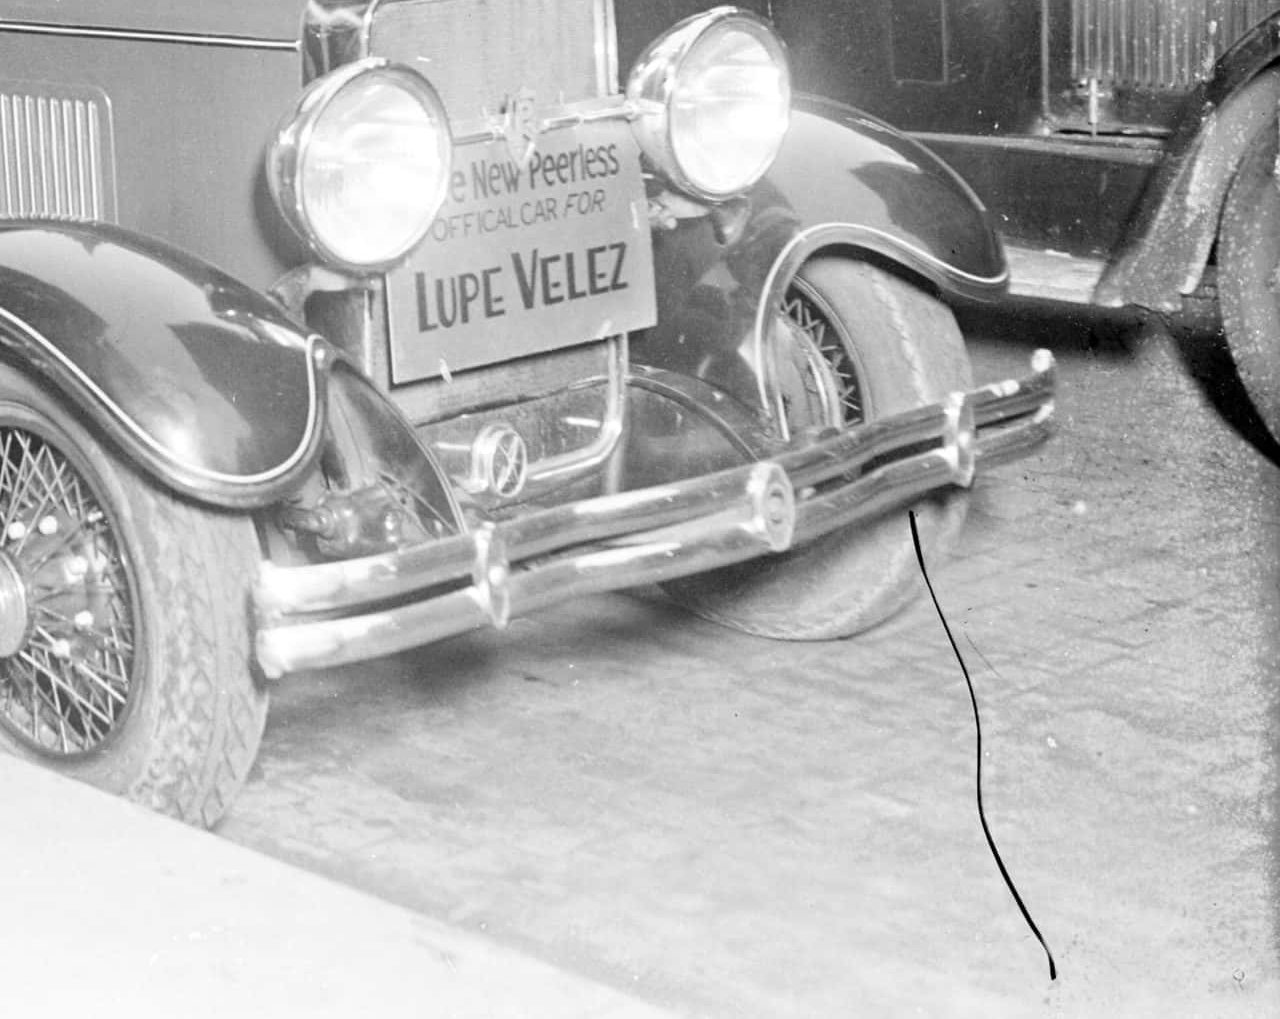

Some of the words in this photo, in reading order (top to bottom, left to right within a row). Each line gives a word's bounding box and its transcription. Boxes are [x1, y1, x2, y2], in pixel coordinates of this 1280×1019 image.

[470, 159, 521, 200] New
[528, 143, 619, 190] Peerless
[520, 197, 558, 226] CAR
[564, 189, 605, 217] FOR
[415, 267, 505, 333] LUPE
[511, 242, 629, 310] VELEZ
